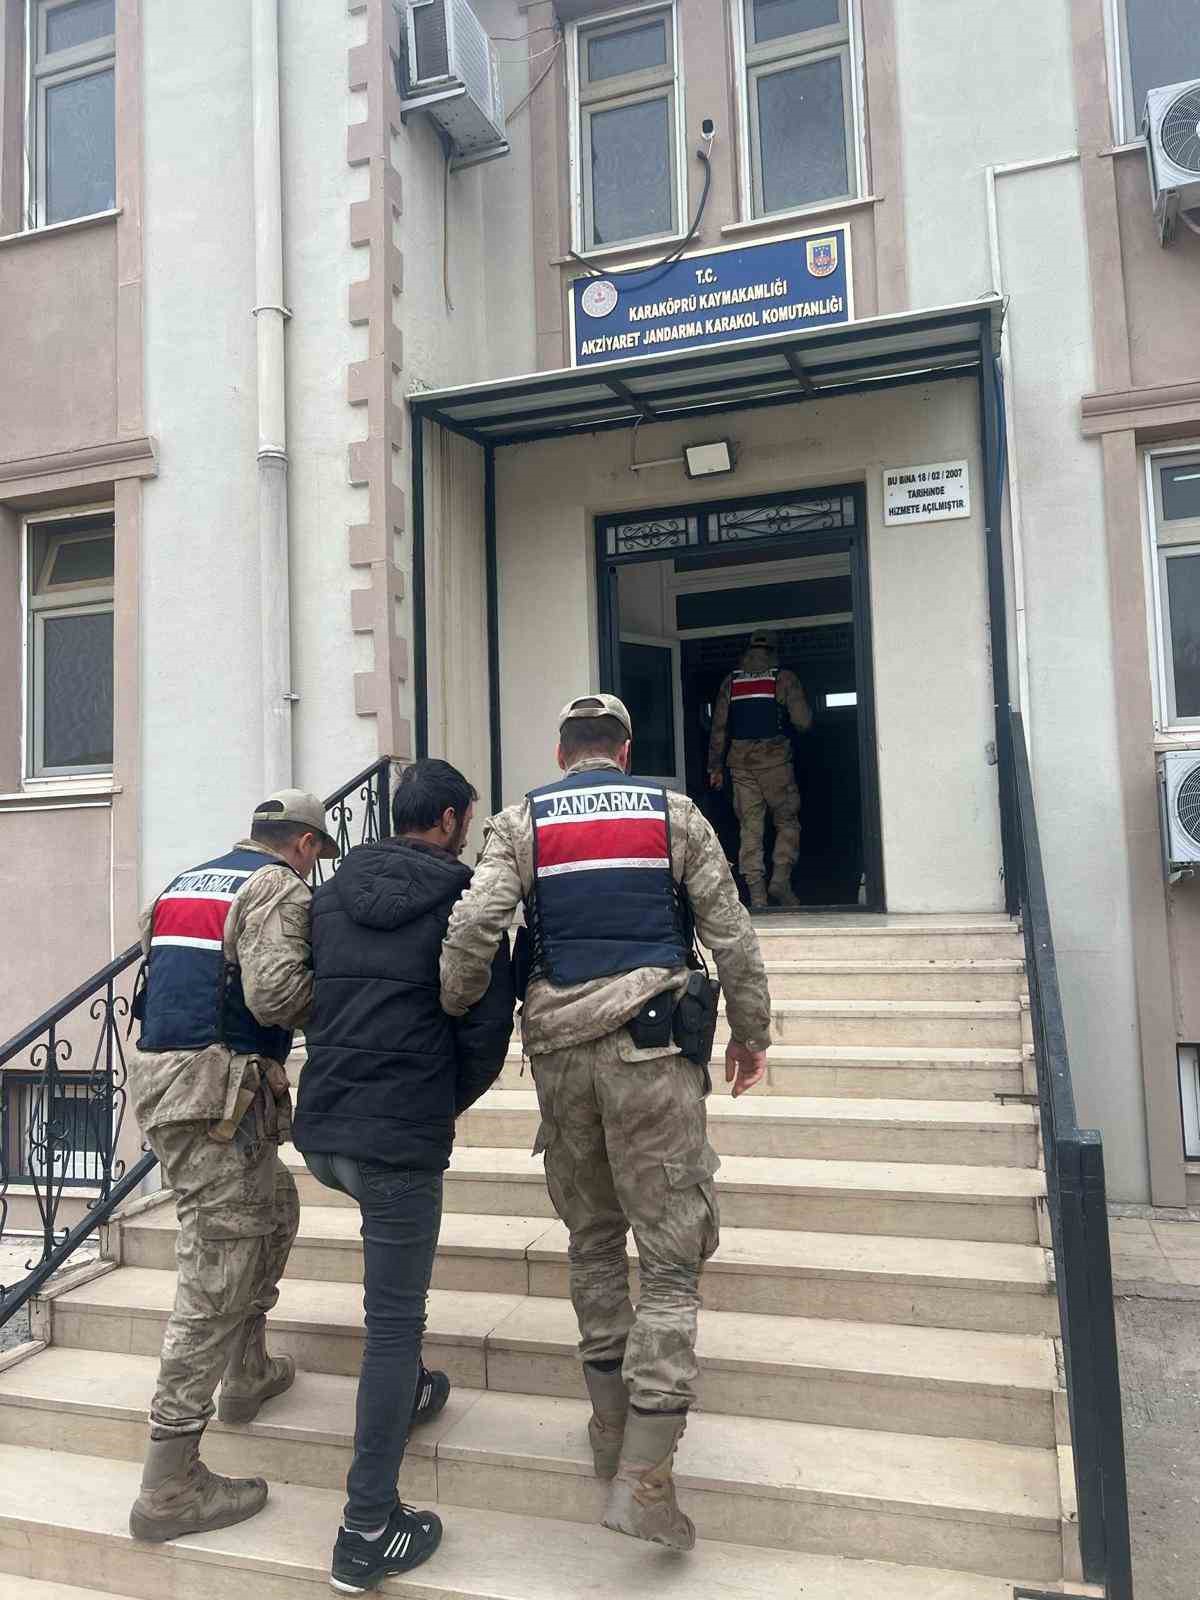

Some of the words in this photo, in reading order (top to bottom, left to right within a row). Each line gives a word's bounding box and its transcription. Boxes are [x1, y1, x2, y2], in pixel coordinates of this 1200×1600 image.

[695, 267, 717, 285] T.C.
[629, 292, 697, 322] KARAKÖPRÜ
[699, 277, 788, 310] KAYMAKAMLIĞI
[581, 331, 641, 356] AKZİYARET
[642, 322, 703, 345] JANDARMA
[705, 313, 760, 334] KARAKOL
[762, 295, 843, 325] KOMUTANLIĞI
[888, 477, 898, 486] BU
[946, 469, 962, 479] 2007
[547, 792, 654, 817] JANDARMA
